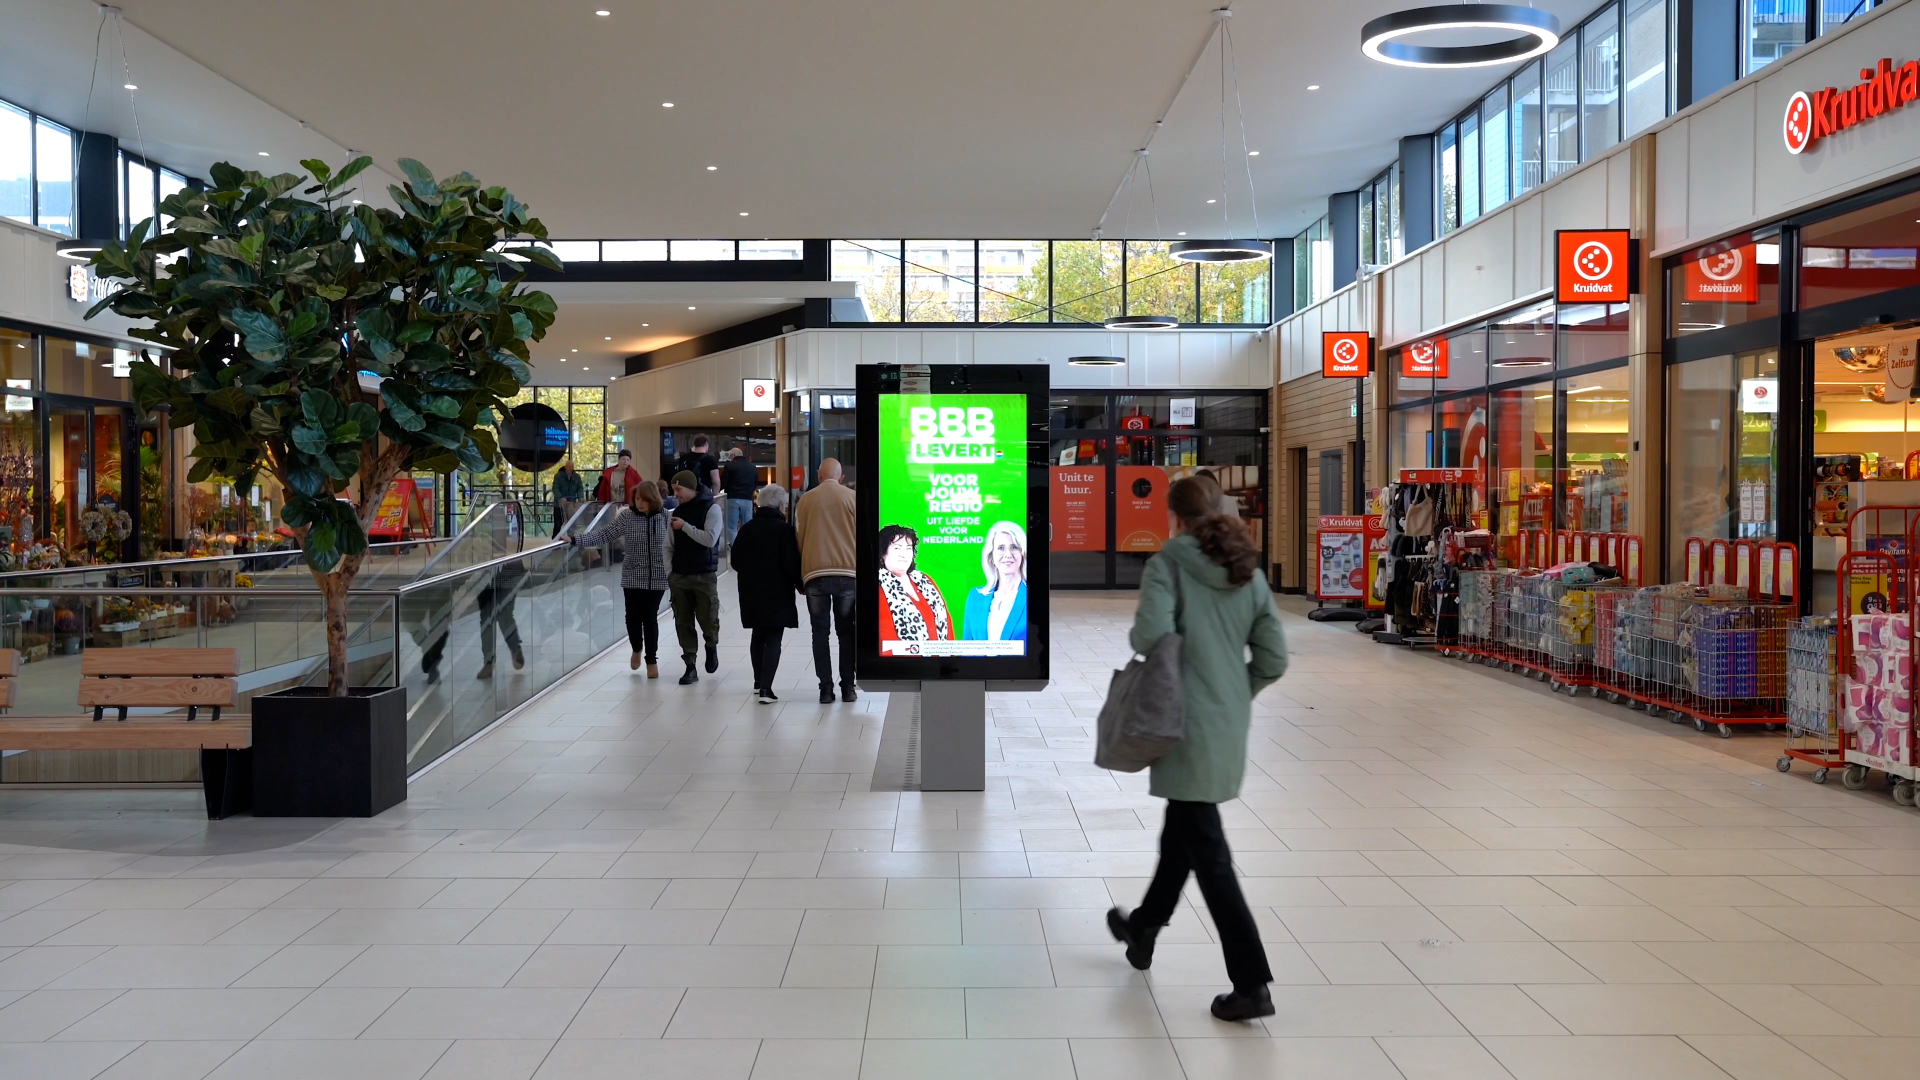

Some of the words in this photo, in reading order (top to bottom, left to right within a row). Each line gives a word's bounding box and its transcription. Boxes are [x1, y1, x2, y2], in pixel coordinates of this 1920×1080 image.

[1814, 57, 1920, 140] Kruidva
[1573, 283, 1613, 293] Kruidvat
[1333, 364, 1358, 372] Kruidvat
[910, 407, 995, 438] BBB
[929, 474, 978, 486] VOOR
[1059, 473, 1081, 482] Unit
[1084, 474, 1094, 482] te
[928, 487, 979, 500] JOUW
[1064, 485, 1092, 494] huur.
[929, 500, 982, 512] REGIO
[1523, 499, 1544, 517] ACTIE!
[927, 517, 943, 525] UIT
[946, 517, 980, 525] LIEFDE
[1329, 519, 1363, 527] Kruidvat
[923, 536, 984, 544] NEDERLAND
